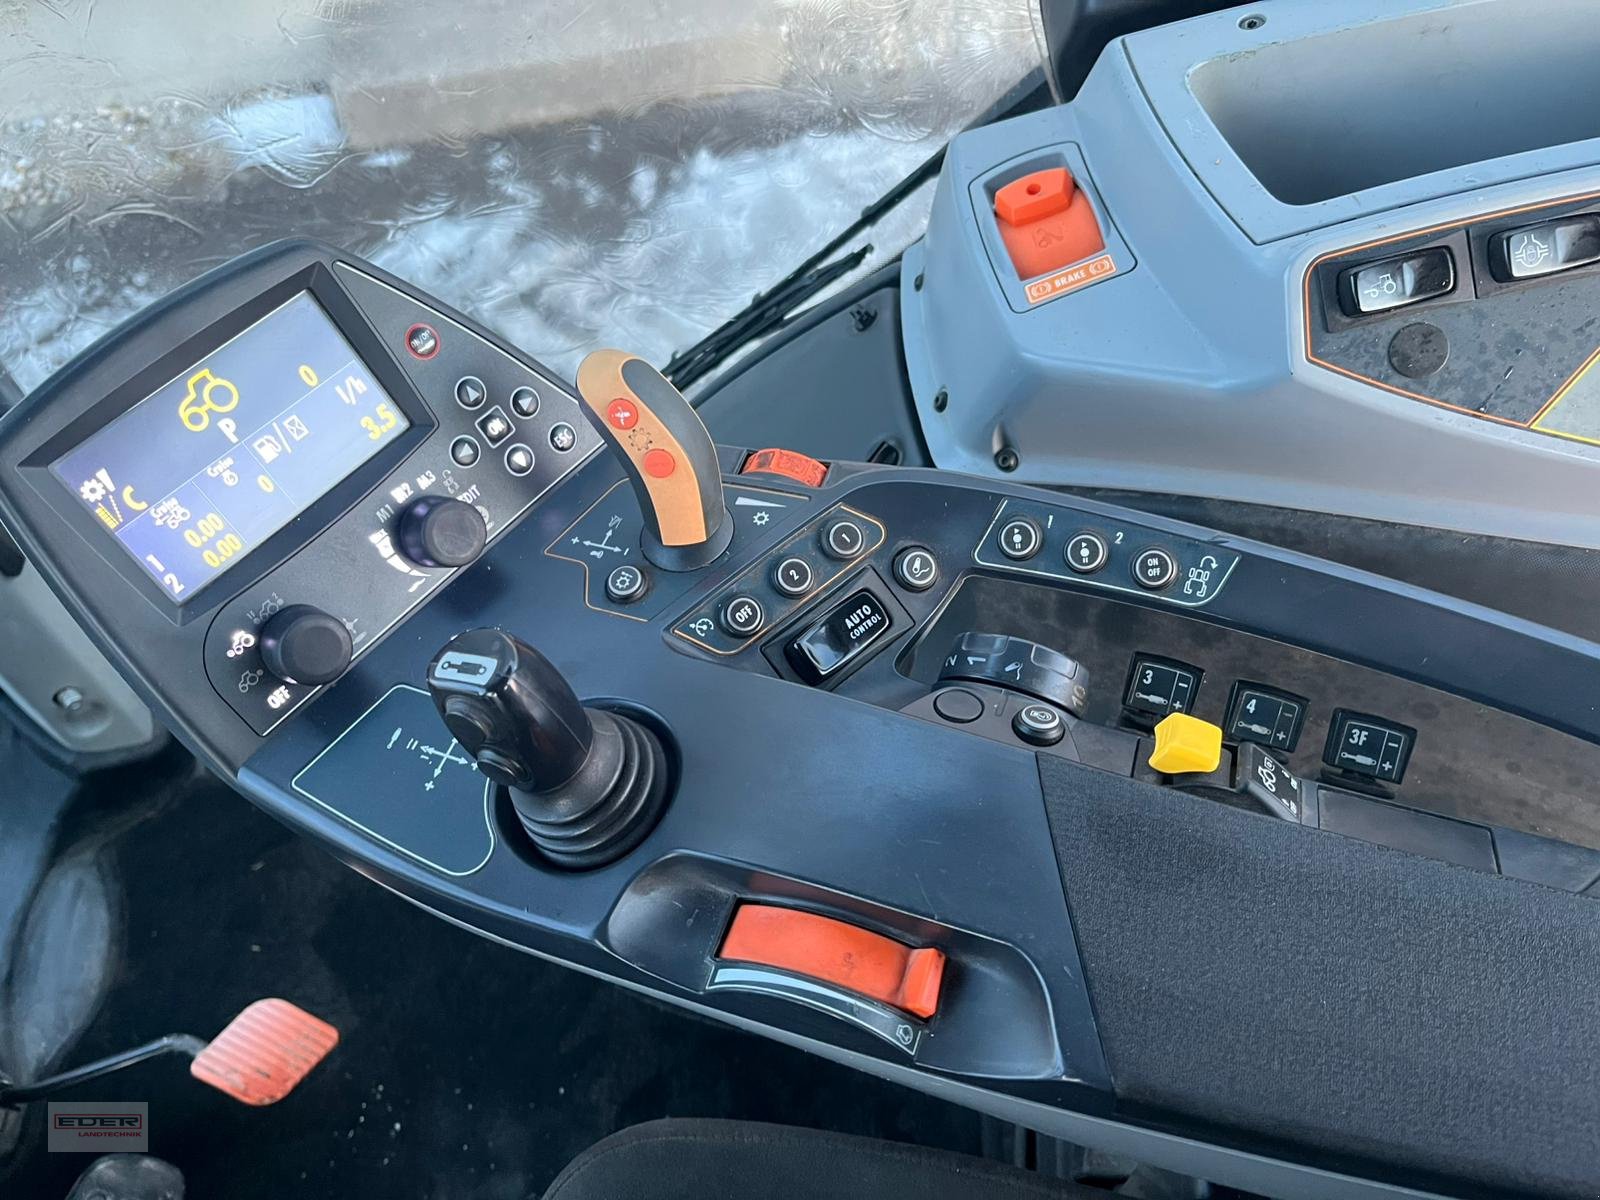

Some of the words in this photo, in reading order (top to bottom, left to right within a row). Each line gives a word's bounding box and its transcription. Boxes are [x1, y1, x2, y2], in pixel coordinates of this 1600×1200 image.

[1054, 269, 1086, 288] BRAKE
[298, 364, 318, 387] 0
[335, 375, 368, 405] l/h
[217, 417, 239, 443] P
[360, 403, 398, 440] 3.5
[553, 429, 573, 447] ESC
[257, 474, 275, 493] 0
[416, 470, 437, 490] M3
[122, 485, 148, 511] C
[375, 503, 396, 523] M1
[1047, 515, 1054, 528] 1
[183, 512, 225, 548] 0.00
[841, 533, 851, 543] 1
[1114, 532, 1124, 545] 2
[203, 533, 242, 568] 0.00
[145, 554, 165, 572] 1
[1147, 558, 1159, 566] ON
[789, 570, 799, 581] 2
[1148, 568, 1161, 577] OFF
[163, 572, 185, 594] 2
[735, 605, 752, 623] OFF
[844, 604, 873, 629] AUTO
[850, 613, 882, 640] CONTROL
[967, 656, 987, 666] 1
[1143, 670, 1154, 685] 3
[267, 685, 291, 709] OFF
[1246, 699, 1256, 714] 4
[1349, 728, 1369, 746] 3F
